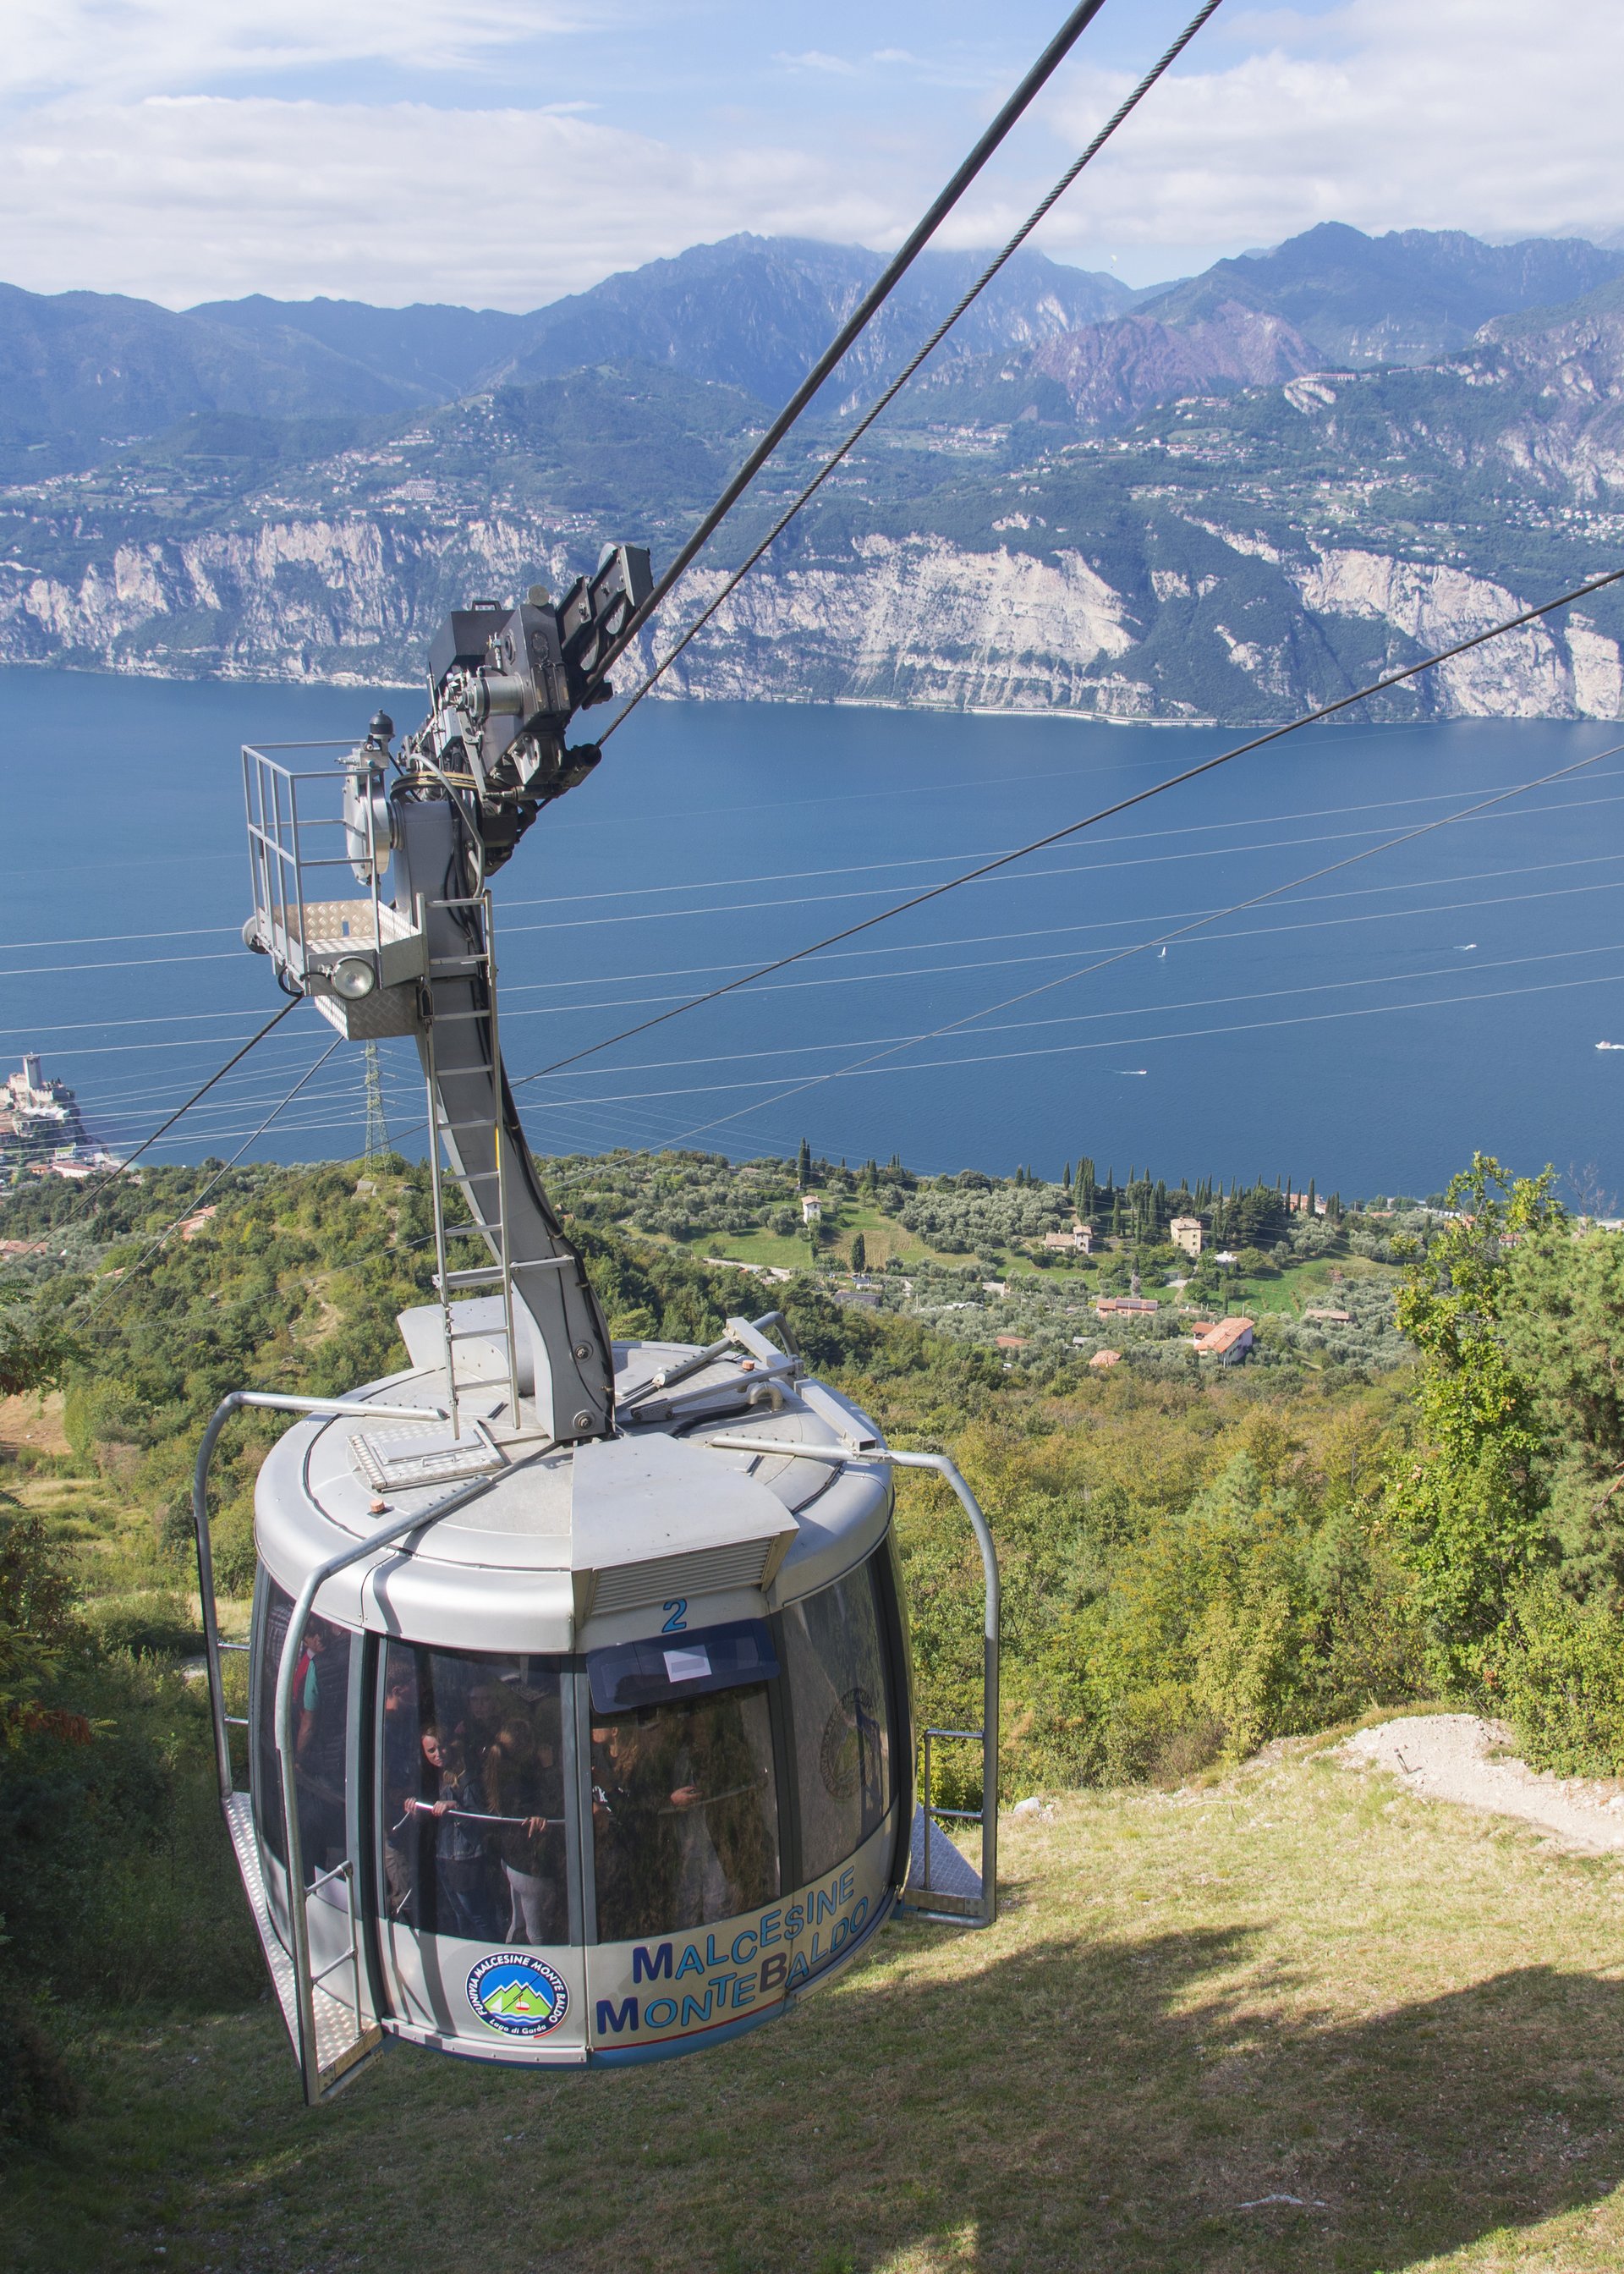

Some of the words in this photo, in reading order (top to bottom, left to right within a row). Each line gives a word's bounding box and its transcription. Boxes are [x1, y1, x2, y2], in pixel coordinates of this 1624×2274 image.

[661, 1598, 688, 1633] 2
[633, 1865, 854, 1984] MALCESINE
[474, 1954, 530, 1979] MALCESINE
[530, 1961, 564, 1991] MONTE
[468, 1978, 487, 2015] FUNIVIA
[548, 1993, 566, 2023] BALDO
[489, 2019, 509, 2031] Lago
[522, 2024, 547, 2035] Garda
